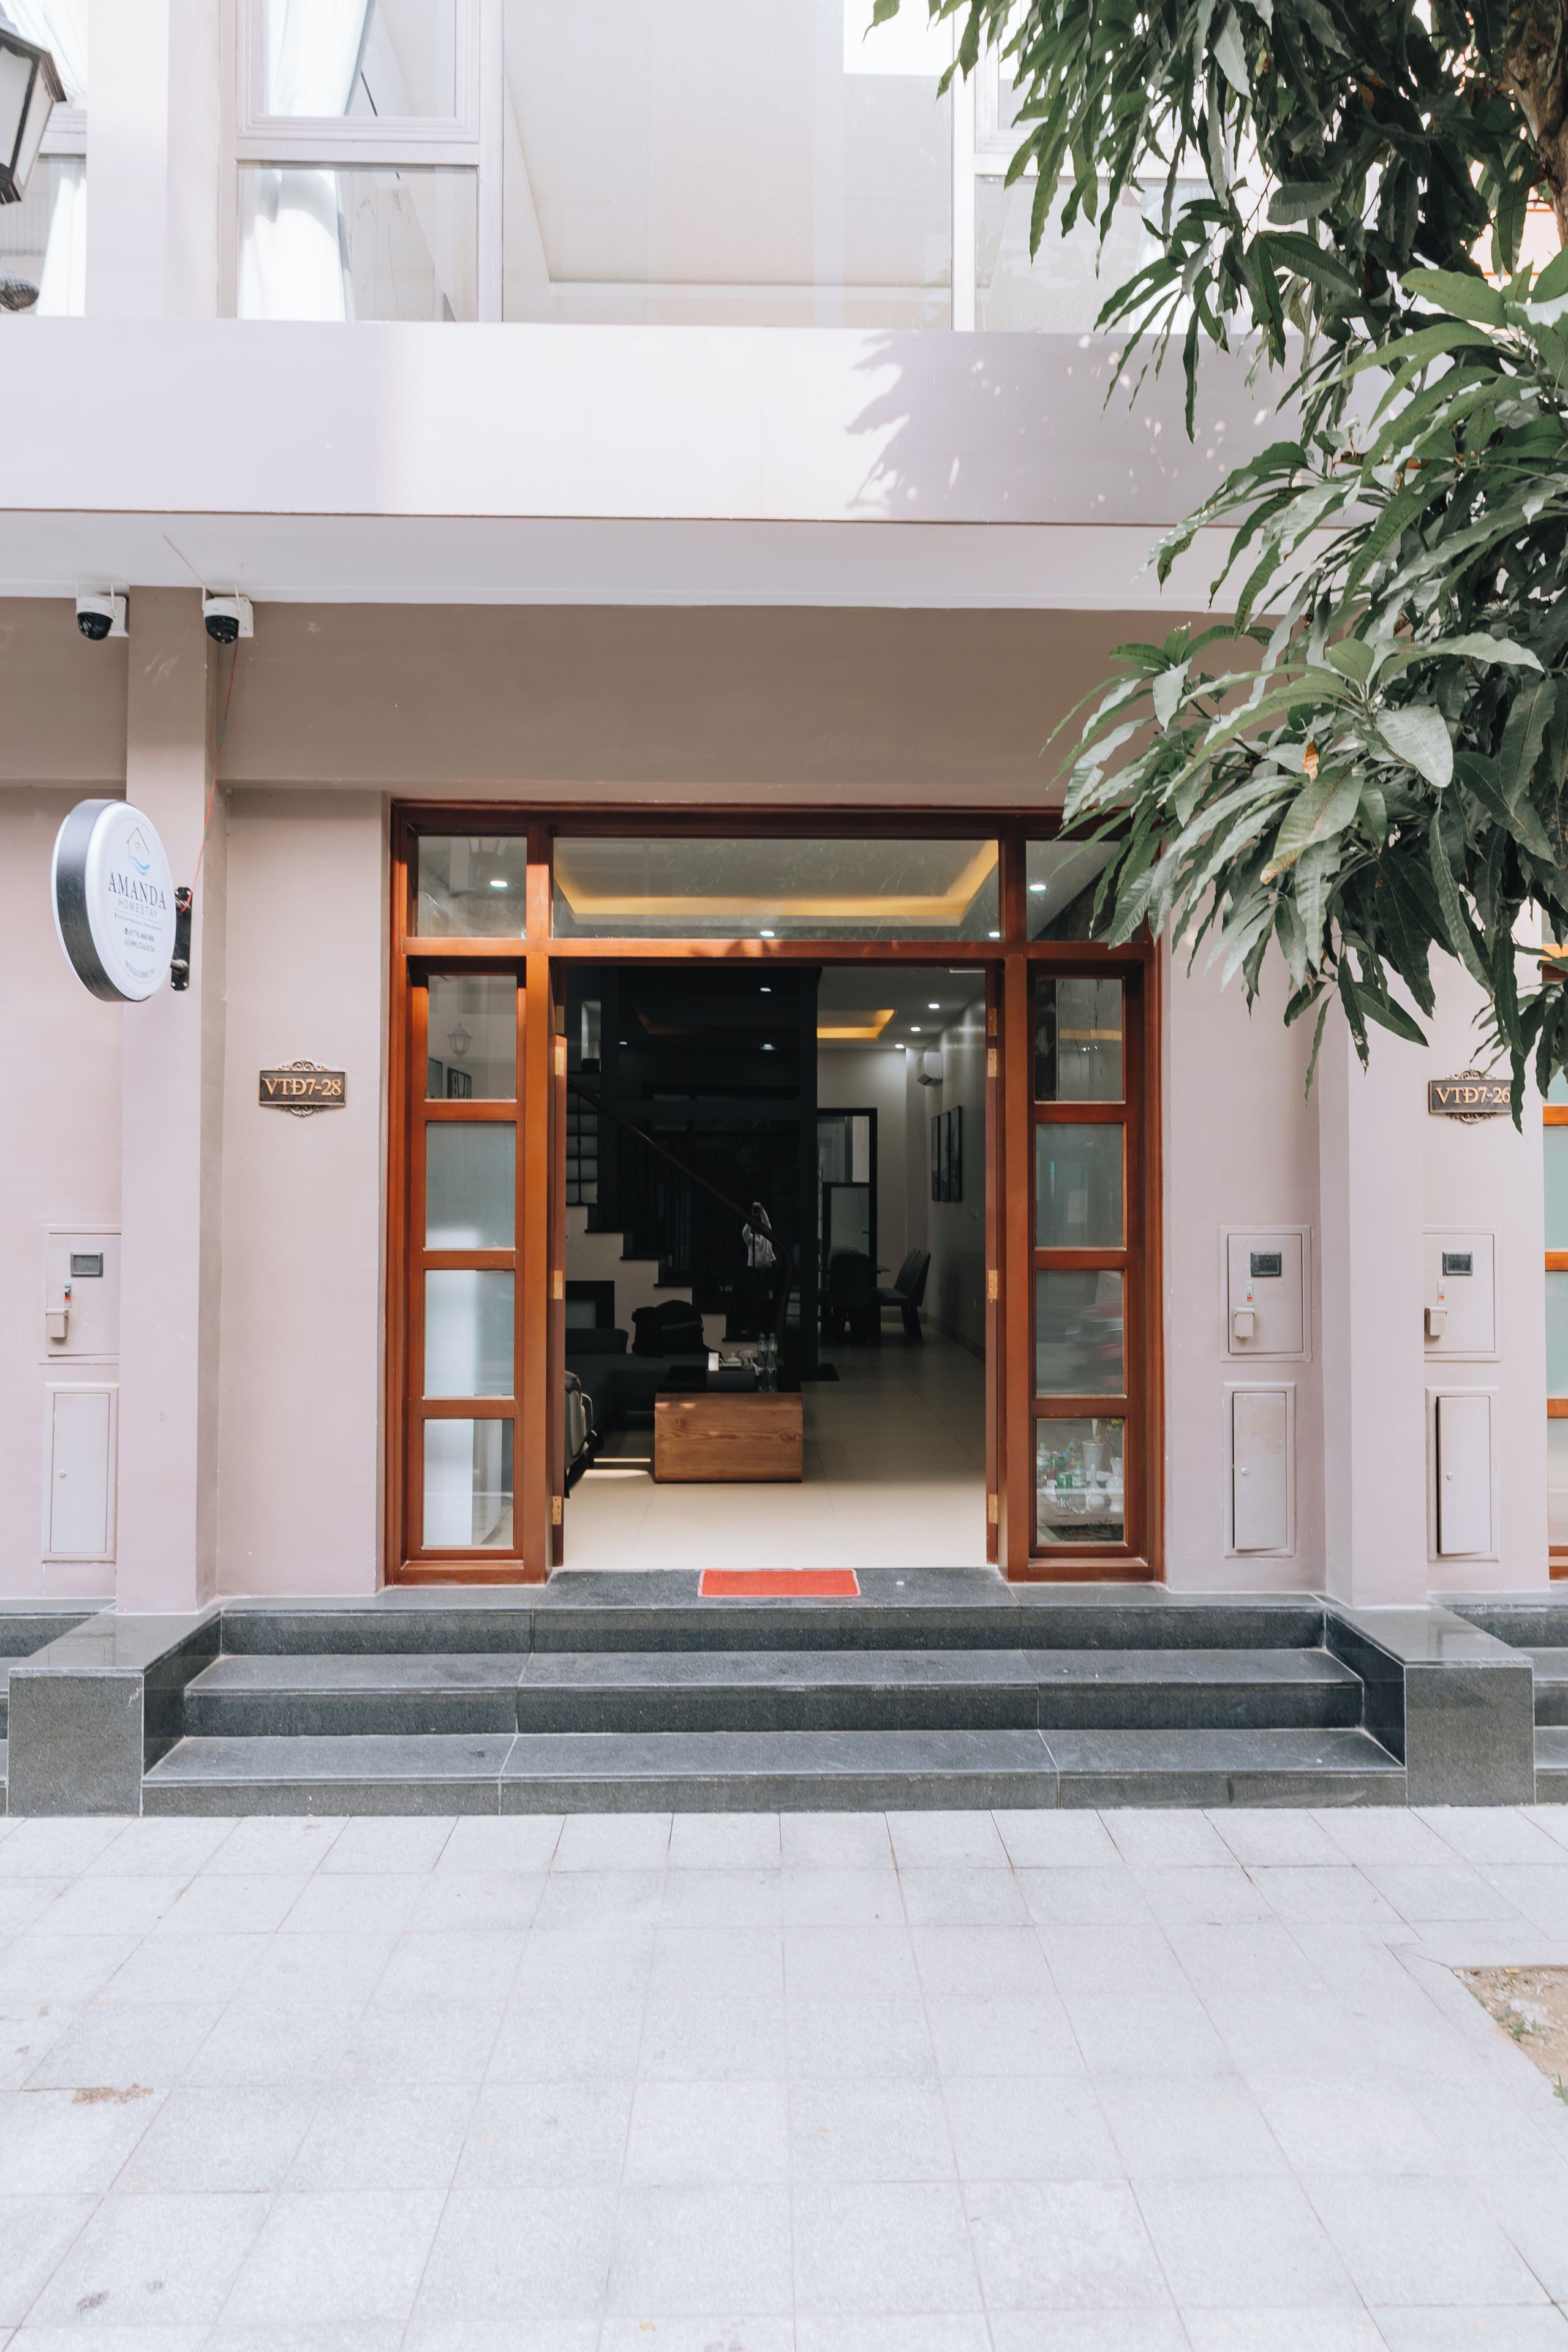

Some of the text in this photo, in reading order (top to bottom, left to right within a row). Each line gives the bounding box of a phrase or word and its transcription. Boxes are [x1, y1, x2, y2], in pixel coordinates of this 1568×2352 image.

[108, 870, 167, 910] AMANDA
[118, 897, 157, 919] HOMESTAY
[264, 1078, 342, 1096] VTĐ7-28
[1436, 1086, 1511, 1104] VTĐ7-26
